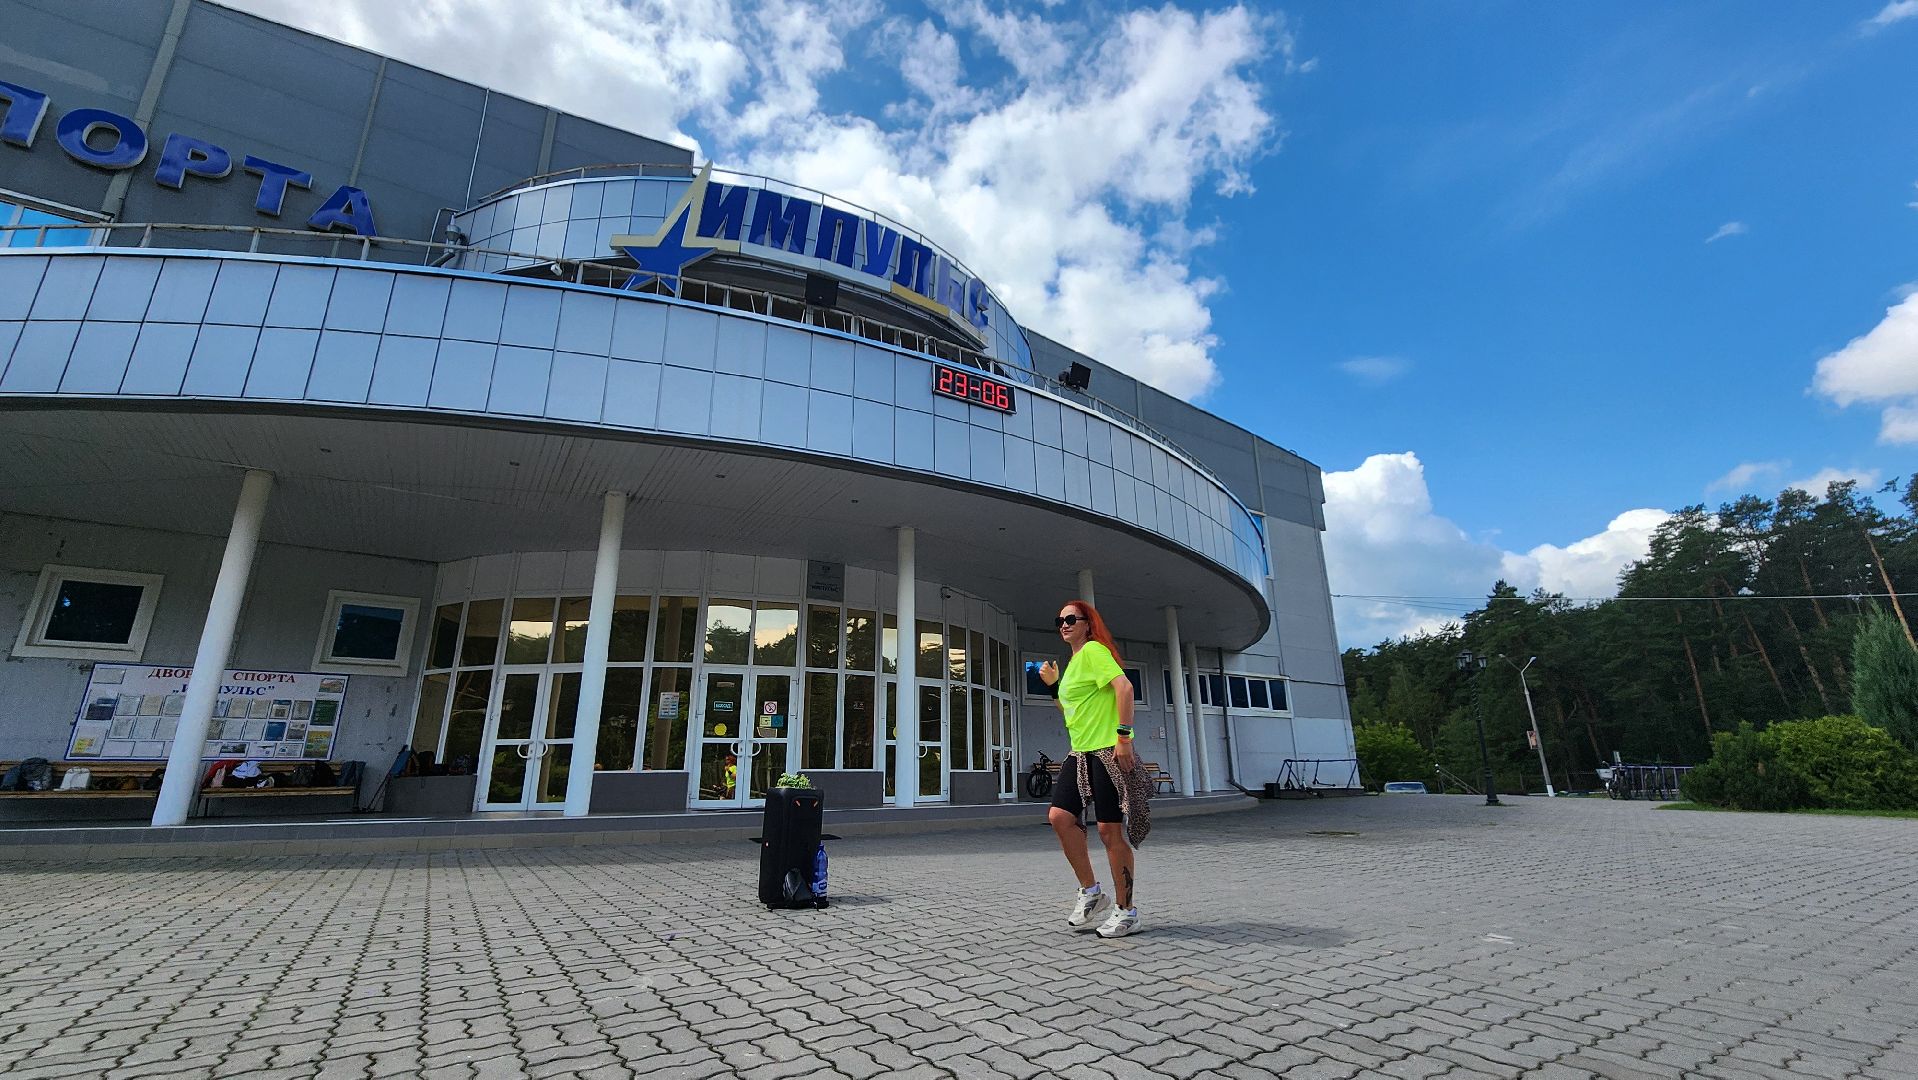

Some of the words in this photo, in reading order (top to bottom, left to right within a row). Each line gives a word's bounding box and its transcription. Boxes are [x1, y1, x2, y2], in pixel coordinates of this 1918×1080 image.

[696, 181, 990, 331] ИМПУЛЬС
[939, 367, 1009, 409] 23-06
[147, 668, 194, 679] ДВОР
[232, 671, 296, 684] СПОРТА
